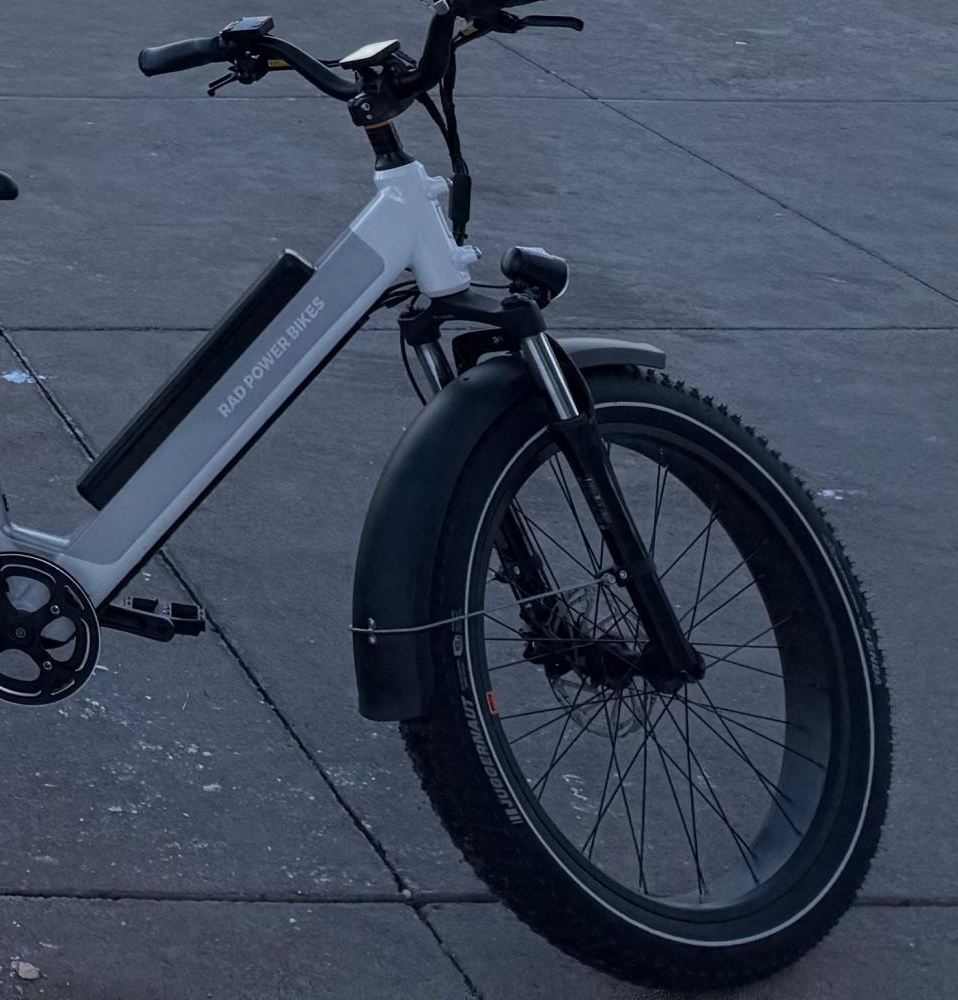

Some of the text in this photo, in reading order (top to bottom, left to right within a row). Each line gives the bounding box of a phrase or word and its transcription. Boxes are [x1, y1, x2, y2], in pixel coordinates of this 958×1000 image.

[217, 296, 325, 418] RAD POWER BIKES
[461, 695, 514, 809] JUGGERNAUT
